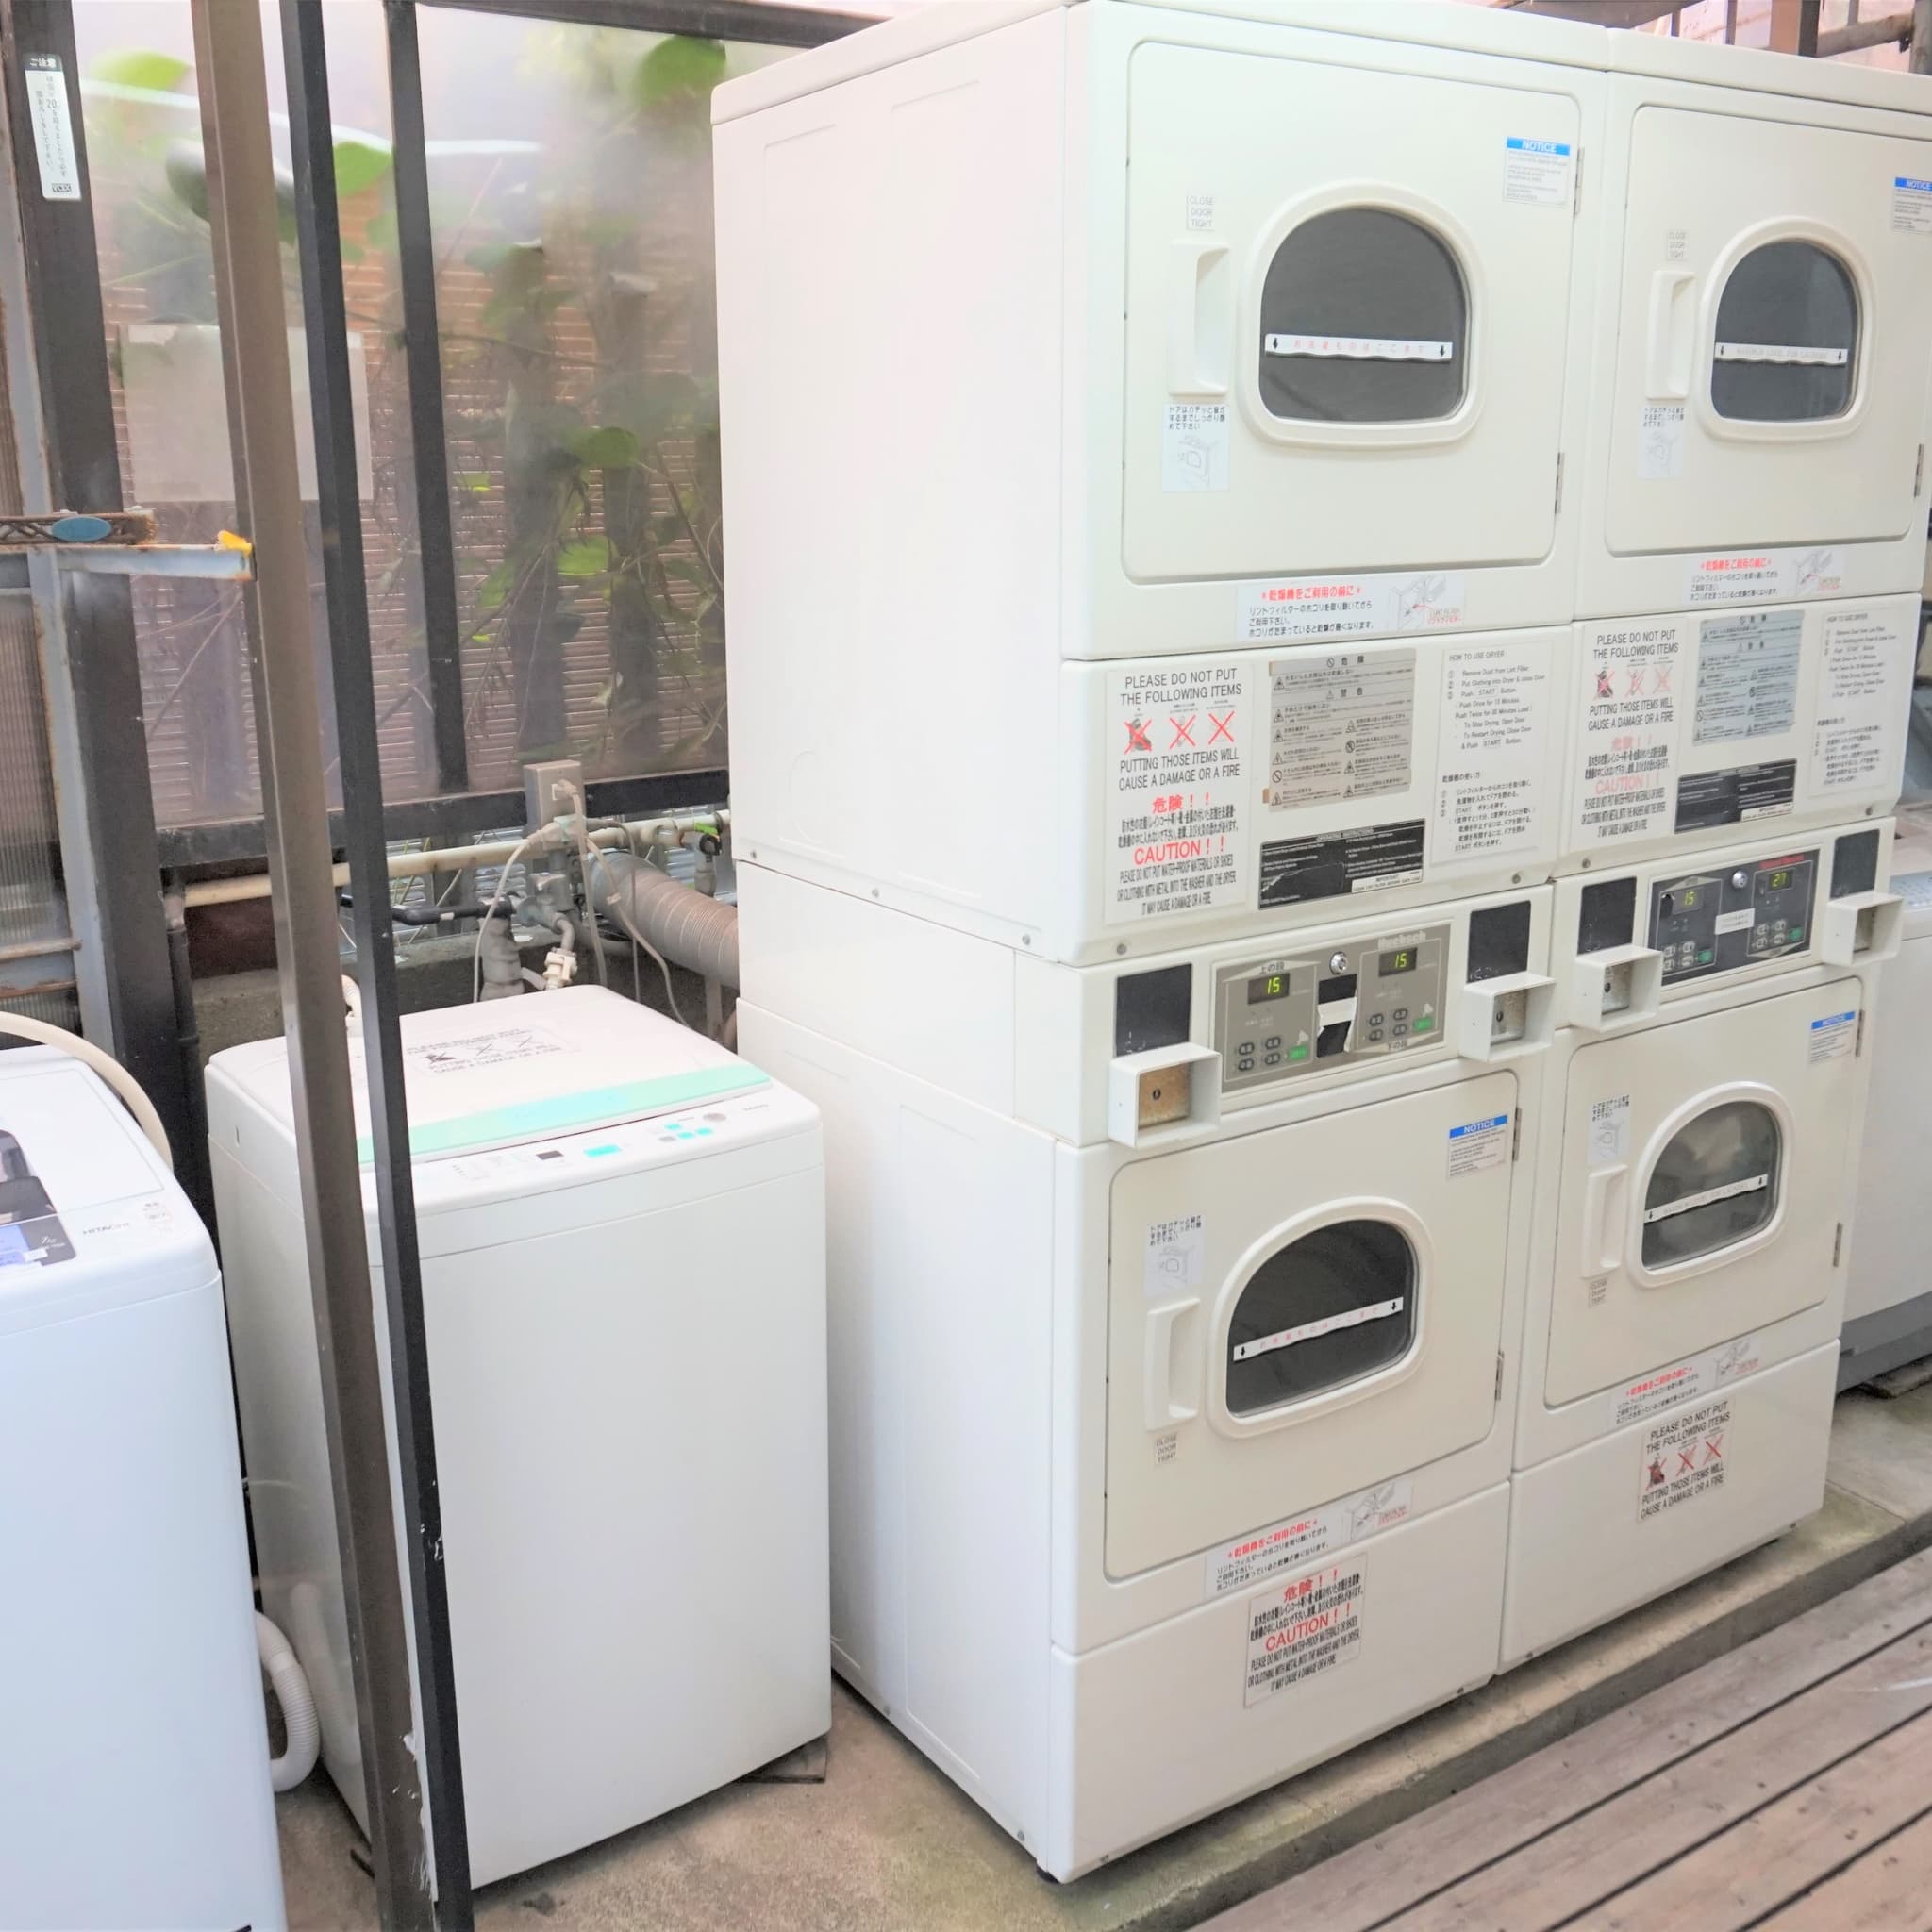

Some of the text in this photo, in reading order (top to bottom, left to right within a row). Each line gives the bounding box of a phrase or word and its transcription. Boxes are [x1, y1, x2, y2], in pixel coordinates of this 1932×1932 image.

[1522, 140, 1557, 153] NOTICE
[1597, 629, 1675, 645] PLEASE DO NOT PUT
[1464, 652, 1472, 660] TO
[1593, 642, 1679, 659] THE FOLLOWING ITEMS
[1125, 668, 1238, 689] PLEASE DO NOT PUT
[1120, 683, 1242, 706] THE FOLLOWING ITEMS
[1590, 704, 1617, 717] PUTTING
[1620, 700, 1640, 712] THOSE
[1641, 698, 1658, 710] ITEMS
[1588, 719, 1609, 731] CAUSE
[1611, 719, 1616, 728] A
[1618, 714, 1643, 728] DAMAGE
[1120, 747, 1240, 773] PUTTING THOSE ITEMS WILL
[1119, 763, 1241, 791] CAUSE A DAMAGE OR A FIRE
[1772, 872, 1789, 887] 27
[1684, 891, 1694, 906] 15
[1394, 952, 1407, 968] 15
[1267, 977, 1280, 994] 15
[1463, 1119, 1495, 1133] NOTICE
[1650, 1401, 1728, 1440] PLEASE DO NOT PUT
[1646, 1411, 1730, 1454] THE FOLLOWING ITEMS
[1642, 1486, 1668, 1506] PUTTING
[1671, 1474, 1690, 1491] THOSE
[1641, 1501, 1661, 1519] CAUSE
[1668, 1486, 1693, 1507] DAMAGE
